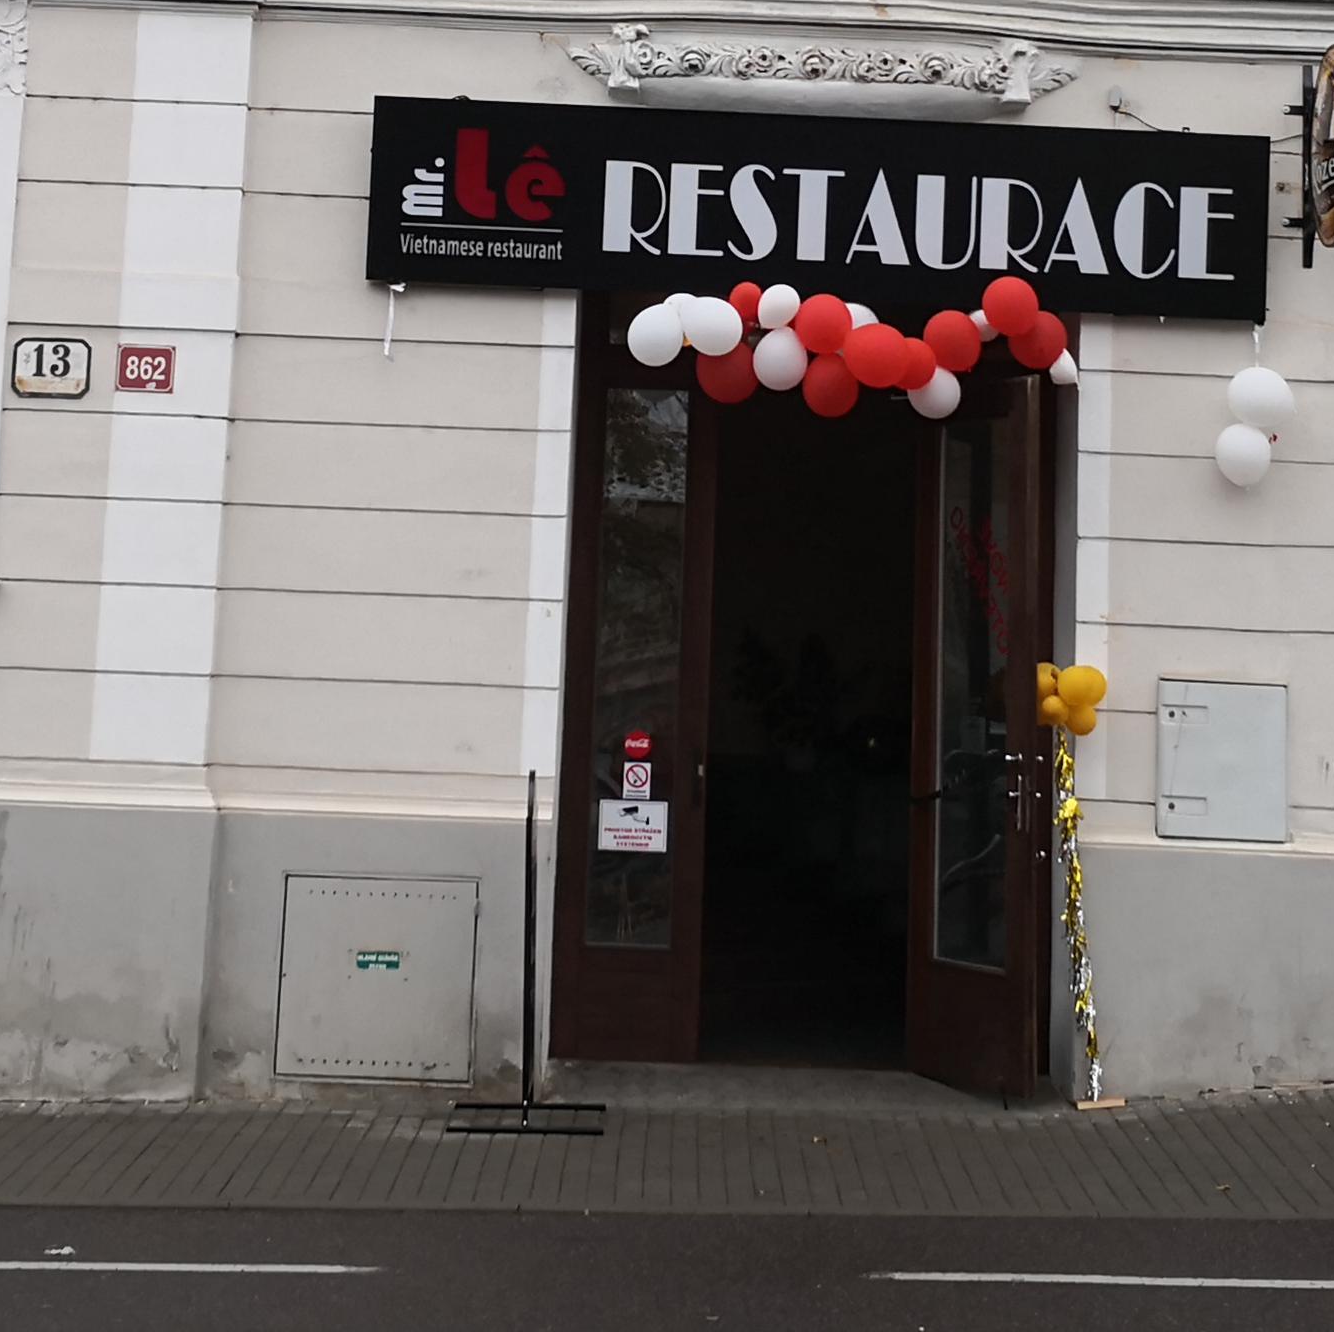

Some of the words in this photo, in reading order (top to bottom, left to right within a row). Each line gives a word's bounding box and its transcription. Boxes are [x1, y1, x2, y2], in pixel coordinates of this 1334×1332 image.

[401, 157, 445, 217] mr.
[602, 159, 1235, 281] RESTAURACE
[400, 233, 484, 257] Vietnamese
[487, 239, 563, 260] restaurant
[32, 343, 71, 378] 13
[125, 355, 166, 381] 862
